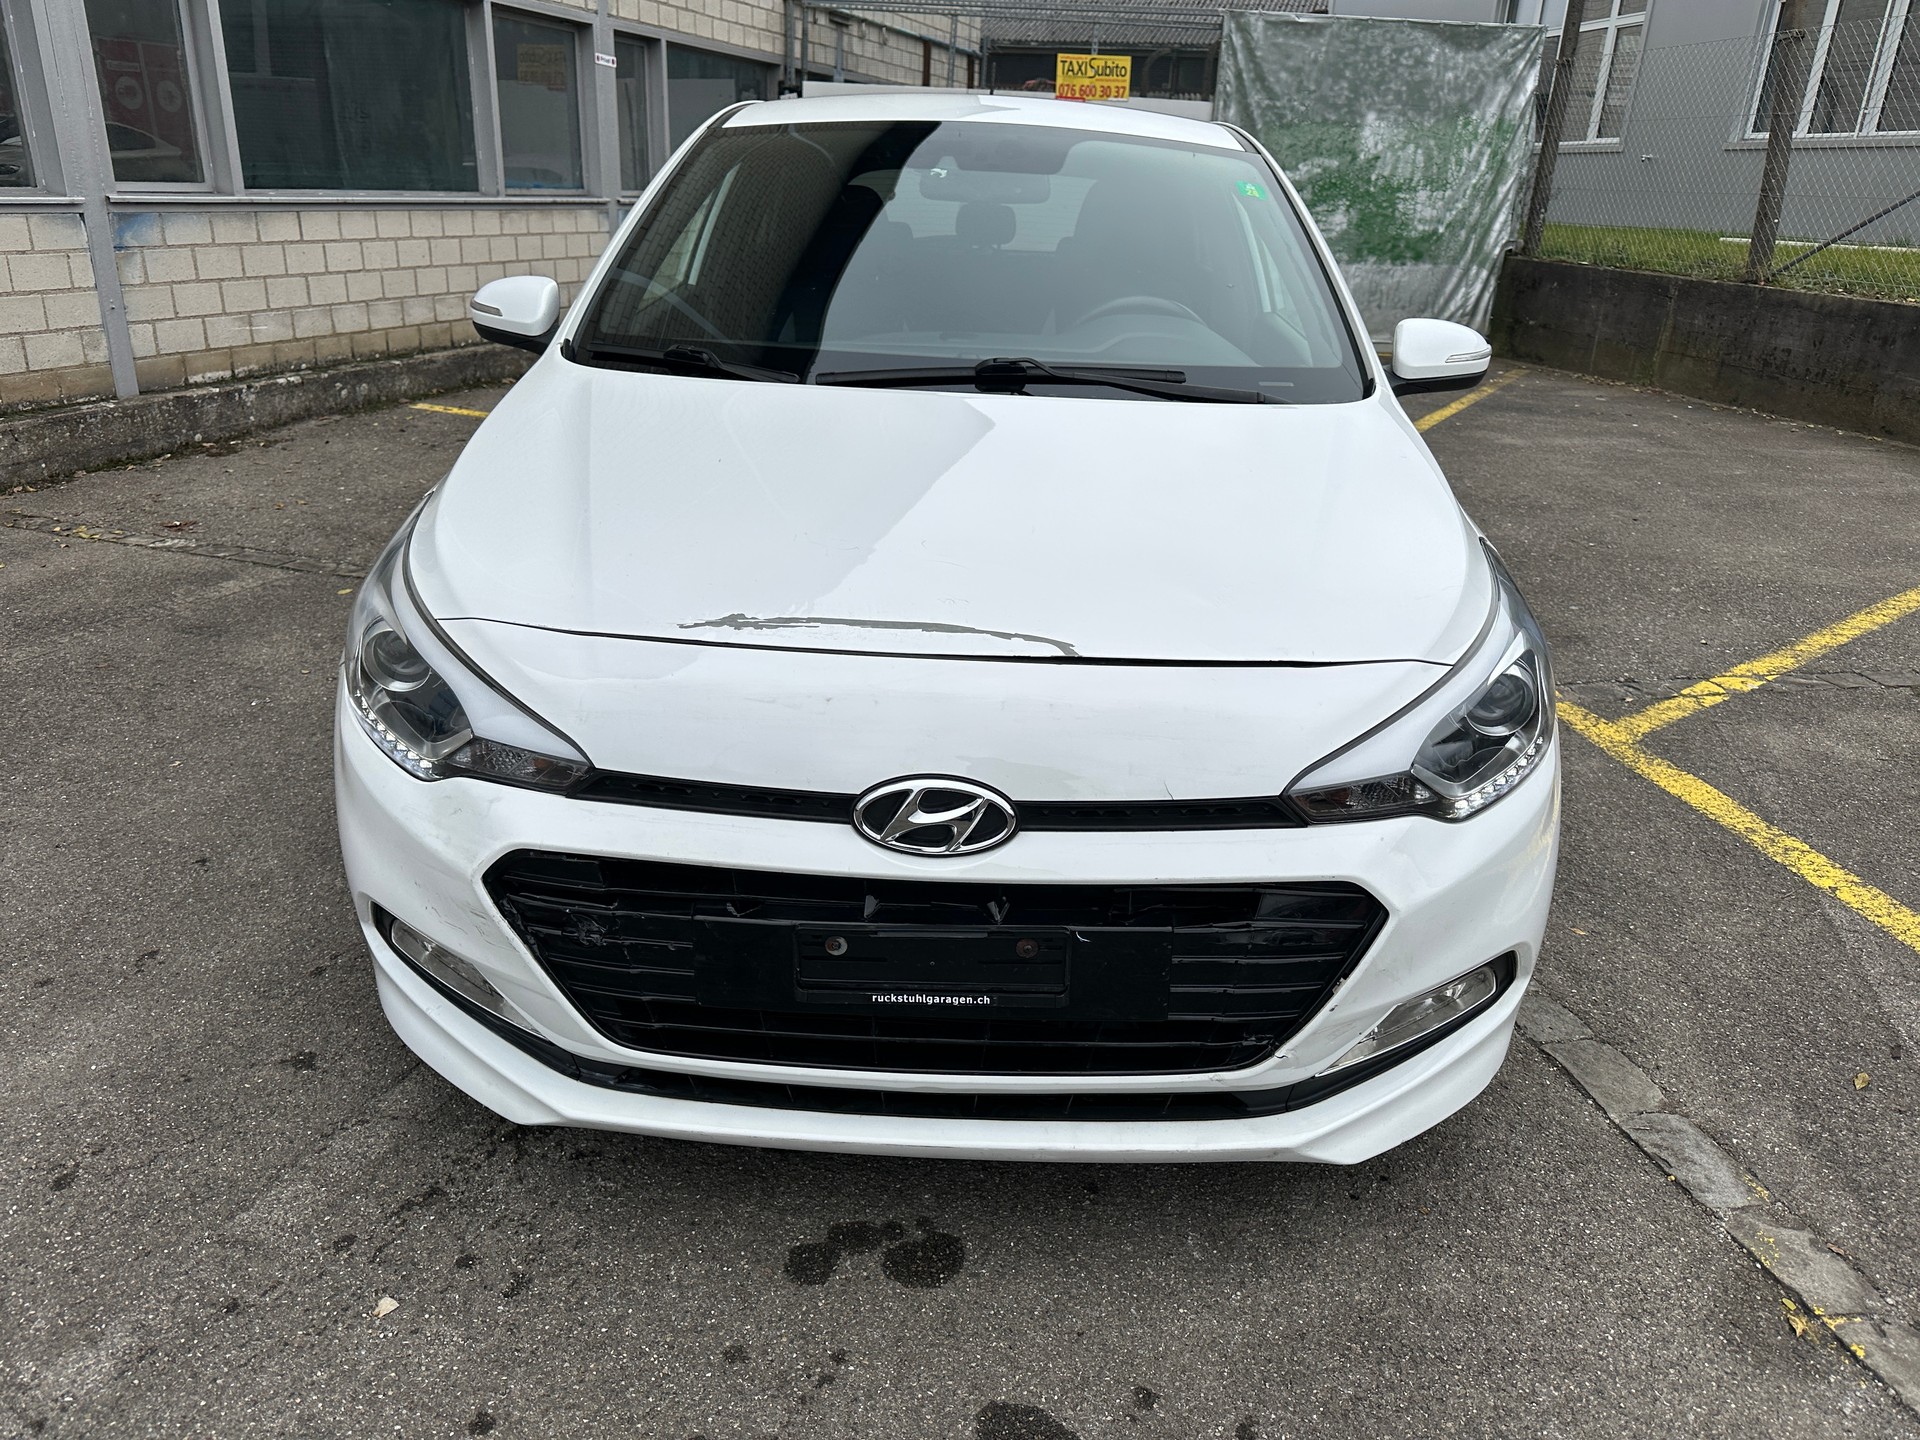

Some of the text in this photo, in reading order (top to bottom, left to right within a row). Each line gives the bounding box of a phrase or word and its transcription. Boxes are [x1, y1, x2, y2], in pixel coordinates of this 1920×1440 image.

[1059, 83, 1127, 98] 076 600 30 37
[872, 993, 991, 1006] ruckstuhlgaragen.ch
